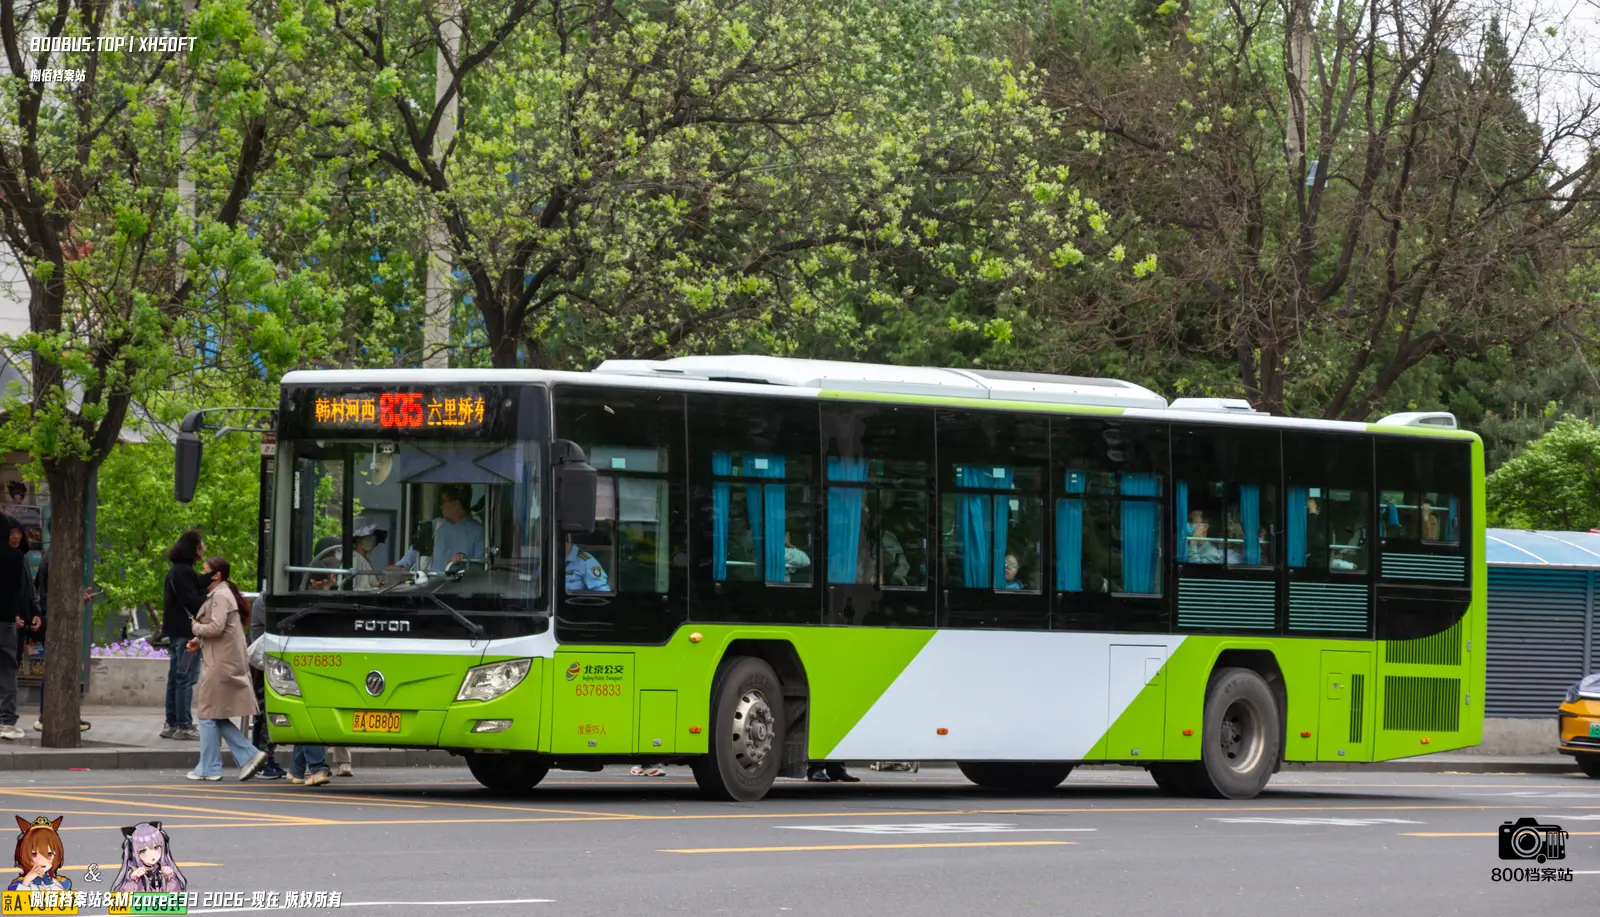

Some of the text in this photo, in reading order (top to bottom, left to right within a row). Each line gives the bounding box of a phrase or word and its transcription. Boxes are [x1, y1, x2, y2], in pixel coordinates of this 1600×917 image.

[315, 397, 376, 423] 韩村河西
[379, 392, 423, 427] 835
[354, 620, 410, 632] FOTON
[293, 654, 342, 667] 6376833
[584, 665, 624, 674] 北京公交
[575, 684, 621, 697] 6376833
